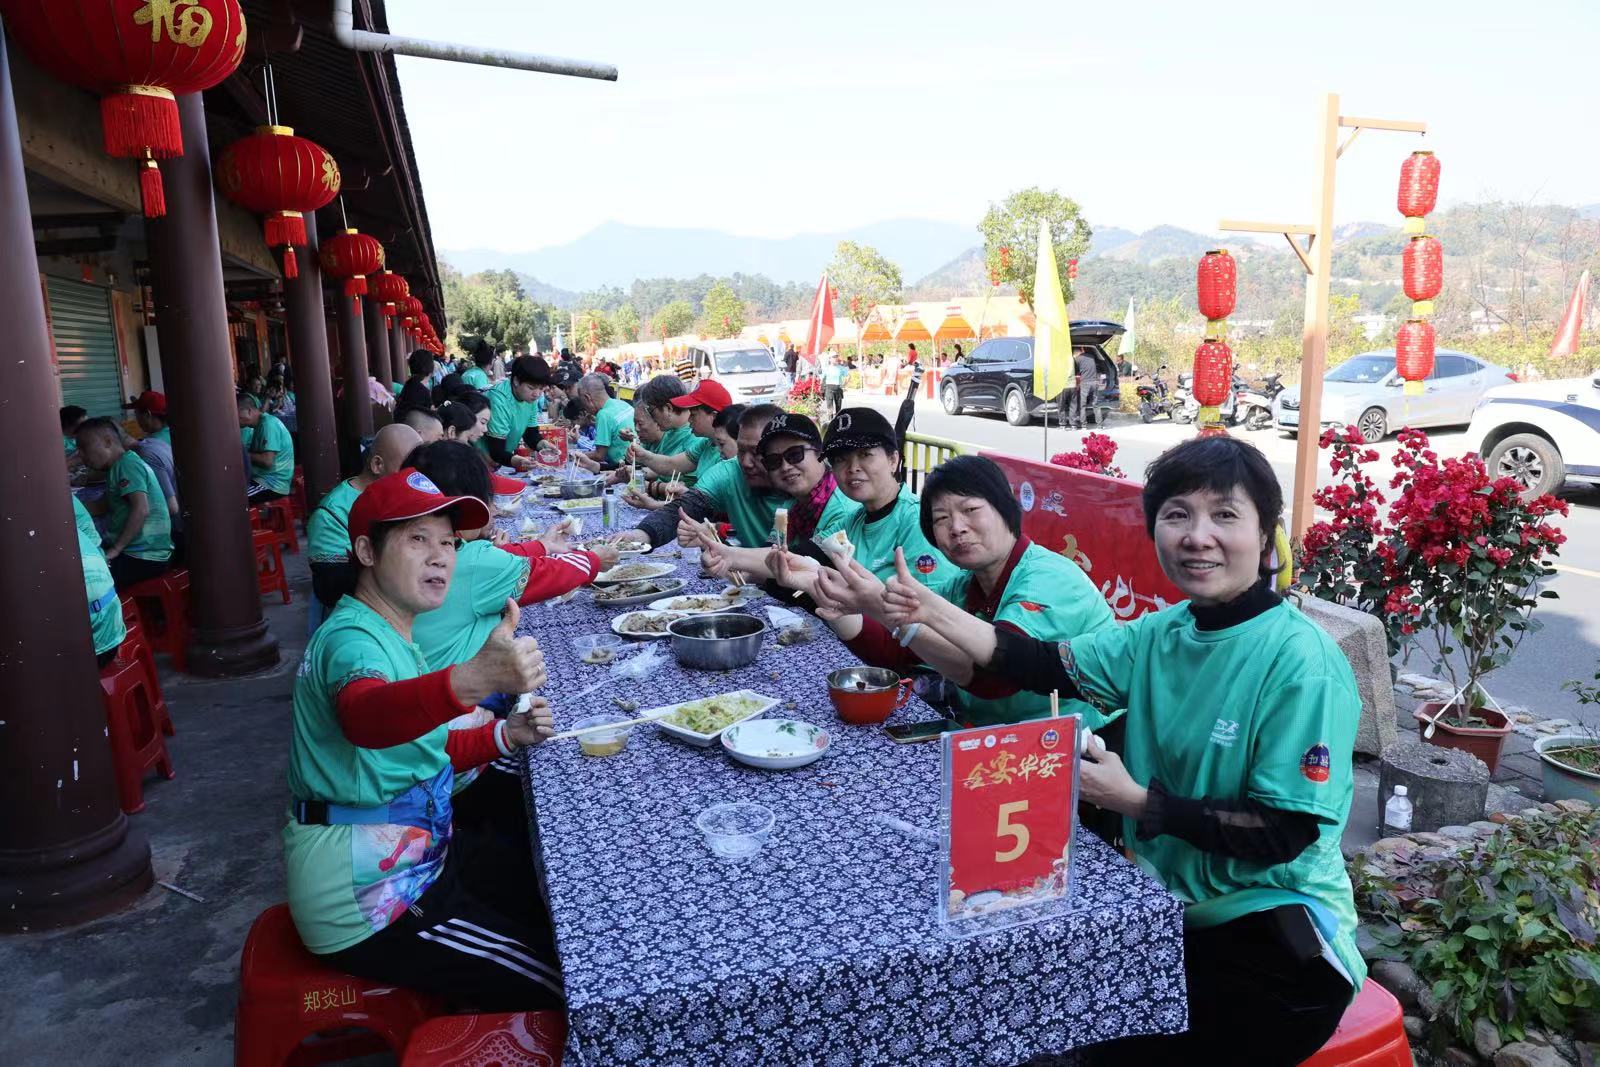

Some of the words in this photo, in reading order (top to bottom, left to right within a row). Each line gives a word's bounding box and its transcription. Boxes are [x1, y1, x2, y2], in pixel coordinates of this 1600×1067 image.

[133, 0, 213, 48] 福
[769, 414, 788, 431] NY
[836, 413, 852, 433] D
[994, 799, 1031, 863] 5
[303, 984, 357, 1013] 郑炎山
